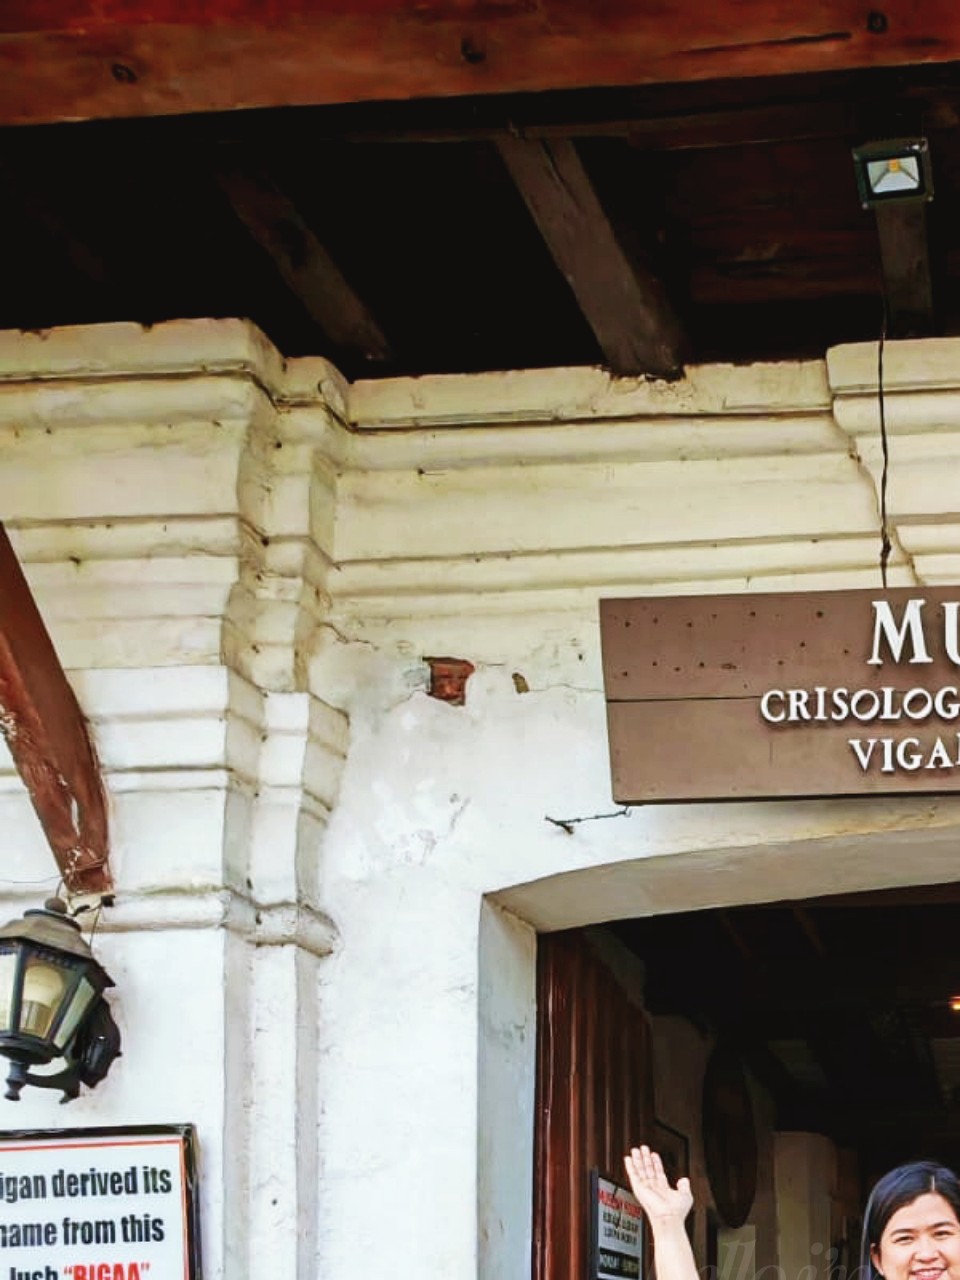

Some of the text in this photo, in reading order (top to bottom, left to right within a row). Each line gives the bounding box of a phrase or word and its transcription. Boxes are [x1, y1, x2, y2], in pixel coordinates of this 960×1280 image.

[52, 1167, 138, 1198] derived
[143, 1166, 172, 1195] its
[63, 1218, 116, 1246] from
[121, 1214, 165, 1243] this
